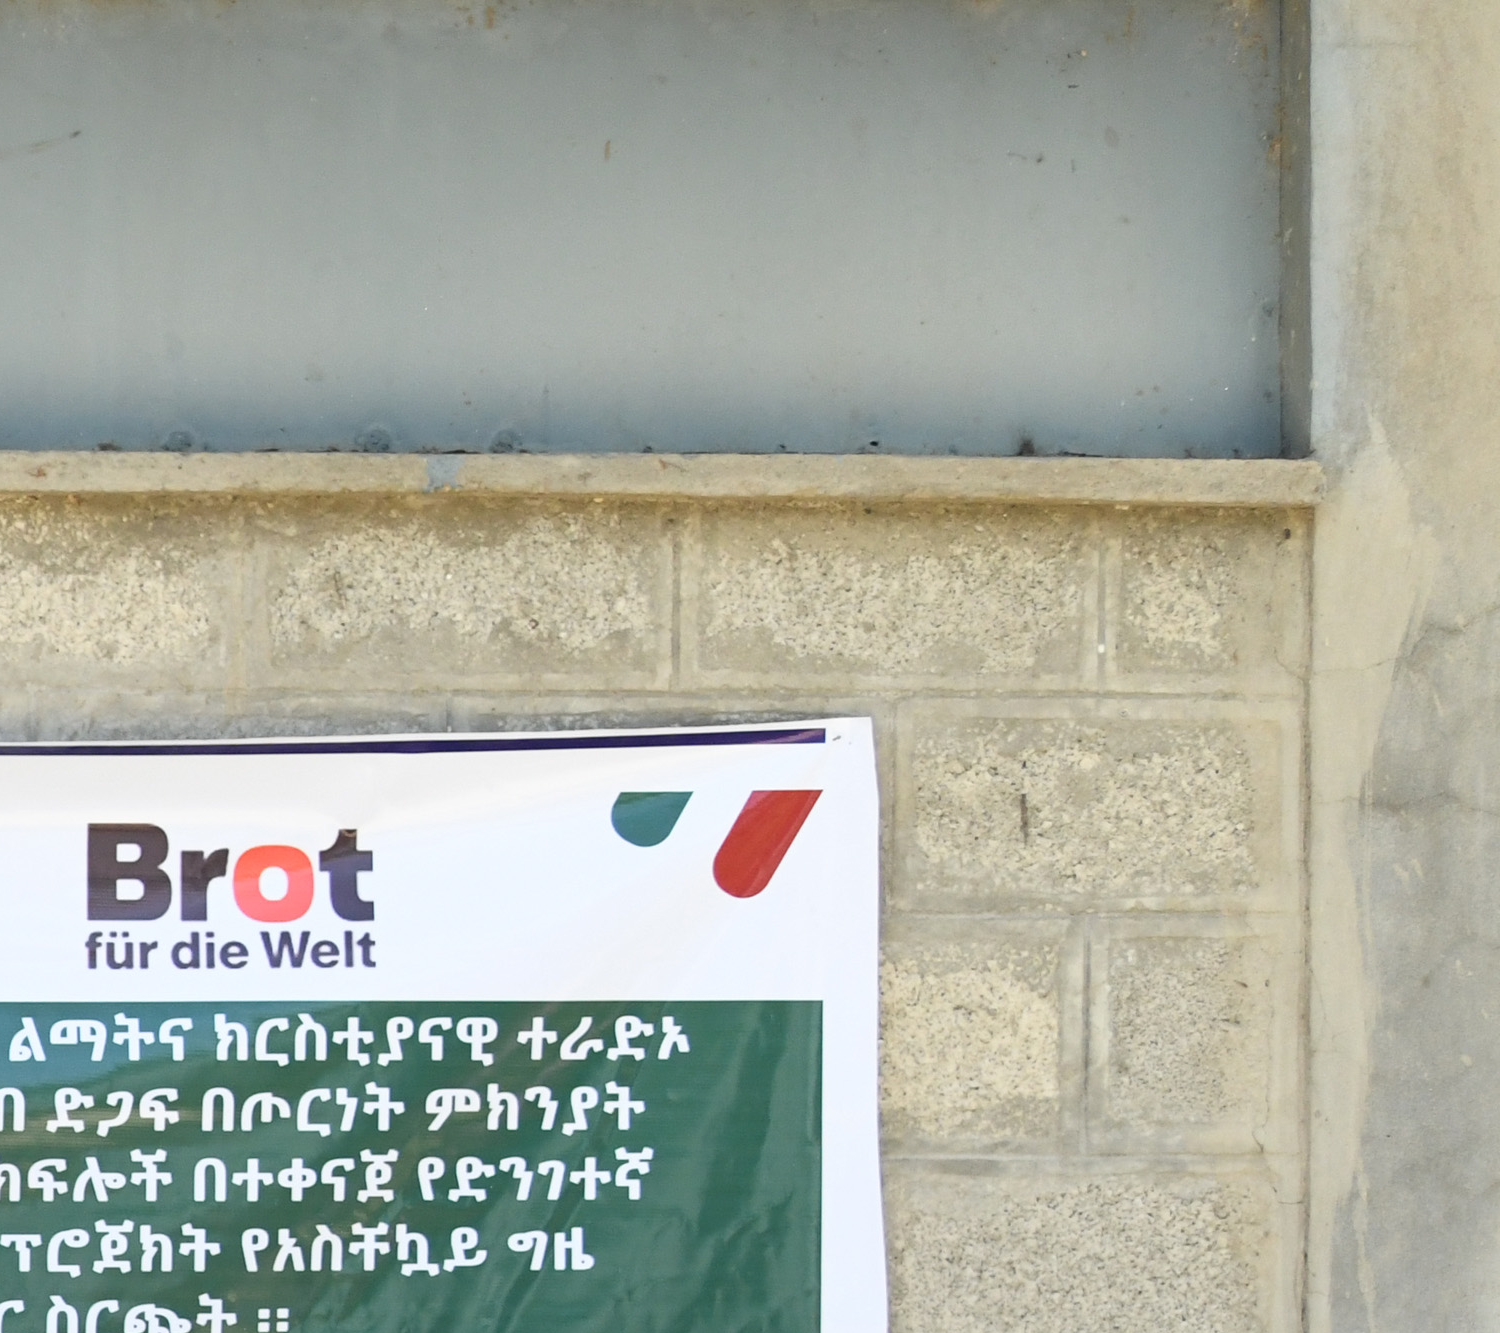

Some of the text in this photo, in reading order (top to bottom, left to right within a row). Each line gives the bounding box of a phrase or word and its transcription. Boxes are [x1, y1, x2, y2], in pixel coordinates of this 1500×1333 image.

[86, 822, 376, 923] Brot
[84, 930, 377, 970] für die Welt
[8, 1012, 194, 1062] ልማትና
[213, 1013, 499, 1066] ክርስቲያናዊ
[516, 1015, 690, 1062] ተራድኦ
[45, 1086, 180, 1137] ድጋፍ
[201, 1082, 406, 1137] በጦርነት
[424, 1081, 646, 1136] ምክንያት
[193, 1149, 399, 1202] በተቀናጀ
[417, 1147, 654, 1202] የድንገተኛ
[0, 1219, 221, 1278] ፕሮጀክት
[241, 1222, 488, 1277] የአስቸኳይ
[507, 1226, 596, 1272] ግዜ
